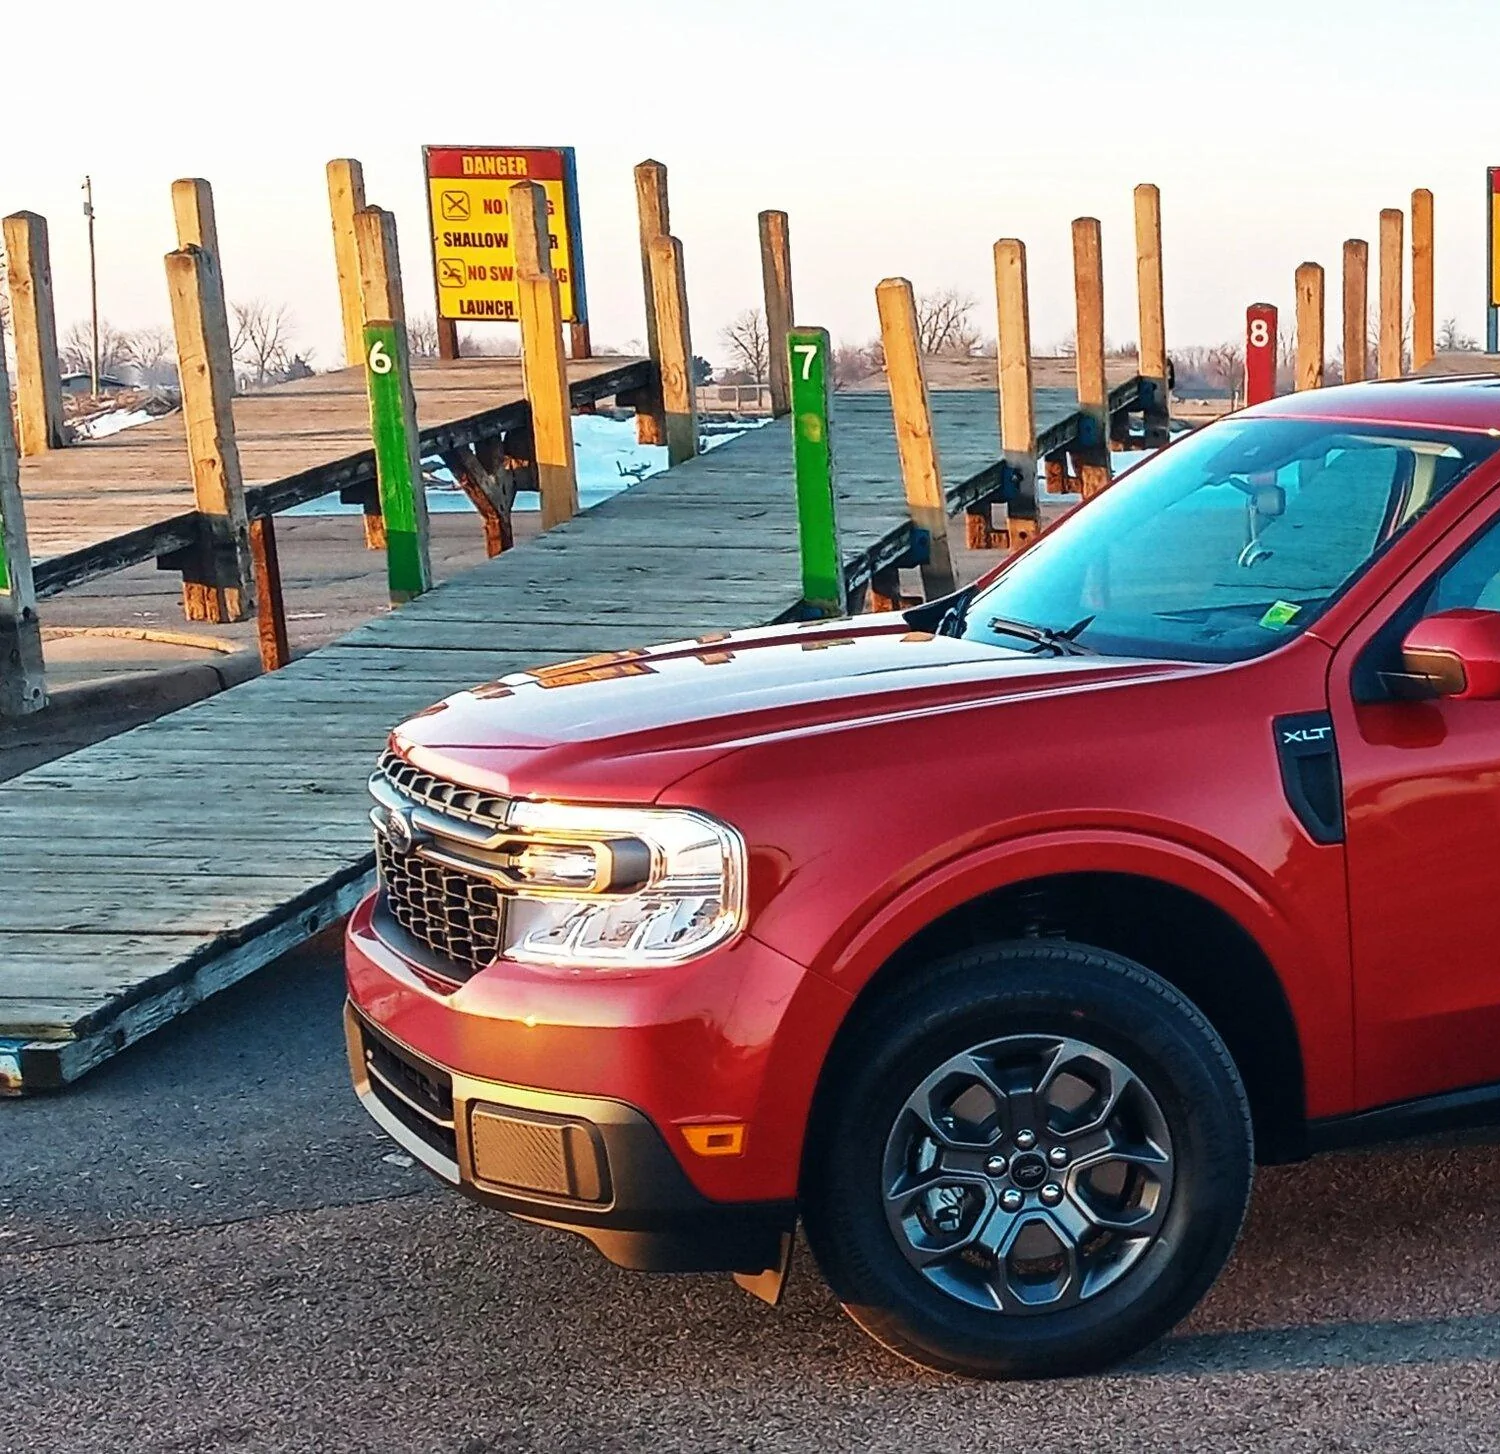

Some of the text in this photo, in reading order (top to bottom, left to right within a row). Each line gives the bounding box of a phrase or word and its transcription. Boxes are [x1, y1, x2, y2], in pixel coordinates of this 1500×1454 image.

[462, 155, 528, 176] DANGER
[483, 199, 503, 215] NO
[443, 231, 509, 248] SHALLOW
[467, 265, 487, 281] NO
[459, 299, 514, 316] LAUNCH
[1250, 319, 1269, 348] 8
[368, 340, 392, 375] 6
[793, 344, 818, 380] 7
[1282, 726, 1332, 744] XLT
